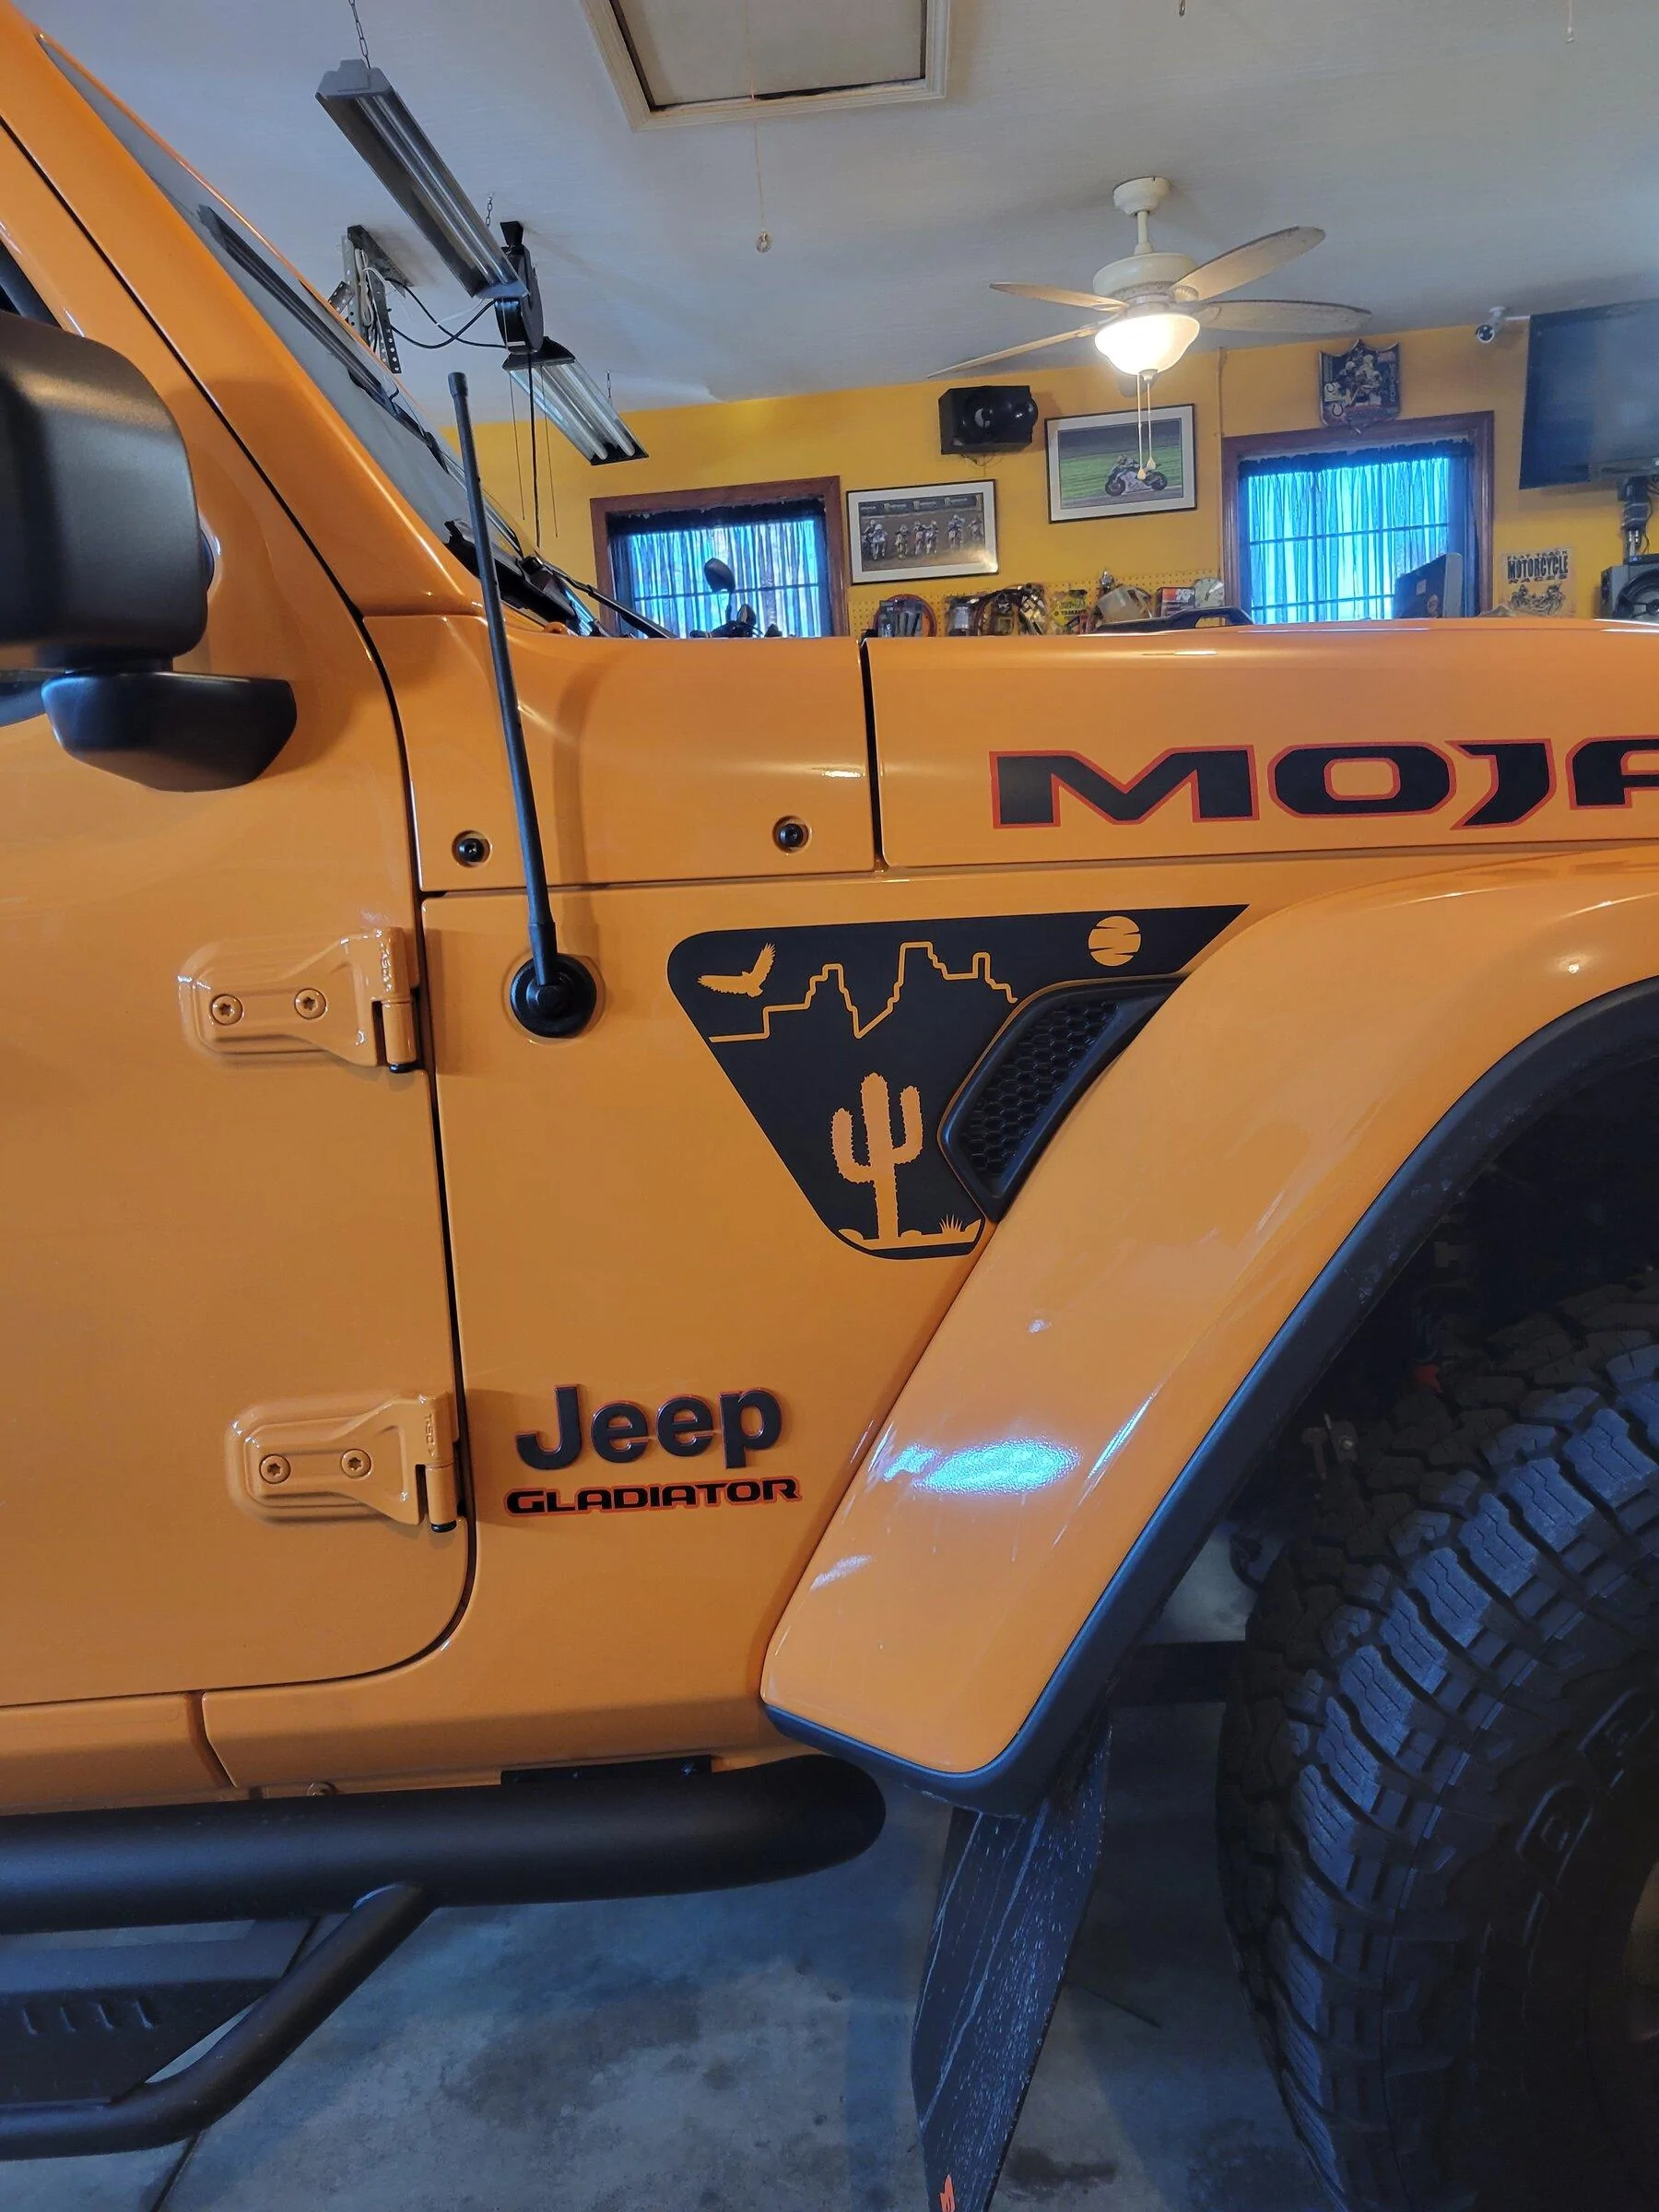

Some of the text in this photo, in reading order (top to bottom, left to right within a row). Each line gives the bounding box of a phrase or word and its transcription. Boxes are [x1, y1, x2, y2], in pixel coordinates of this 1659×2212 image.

[1507, 555, 1569, 580] MOTORCYCLE
[515, 1383, 782, 1470] Jeep
[504, 1476, 801, 1517] GLADIATOR
